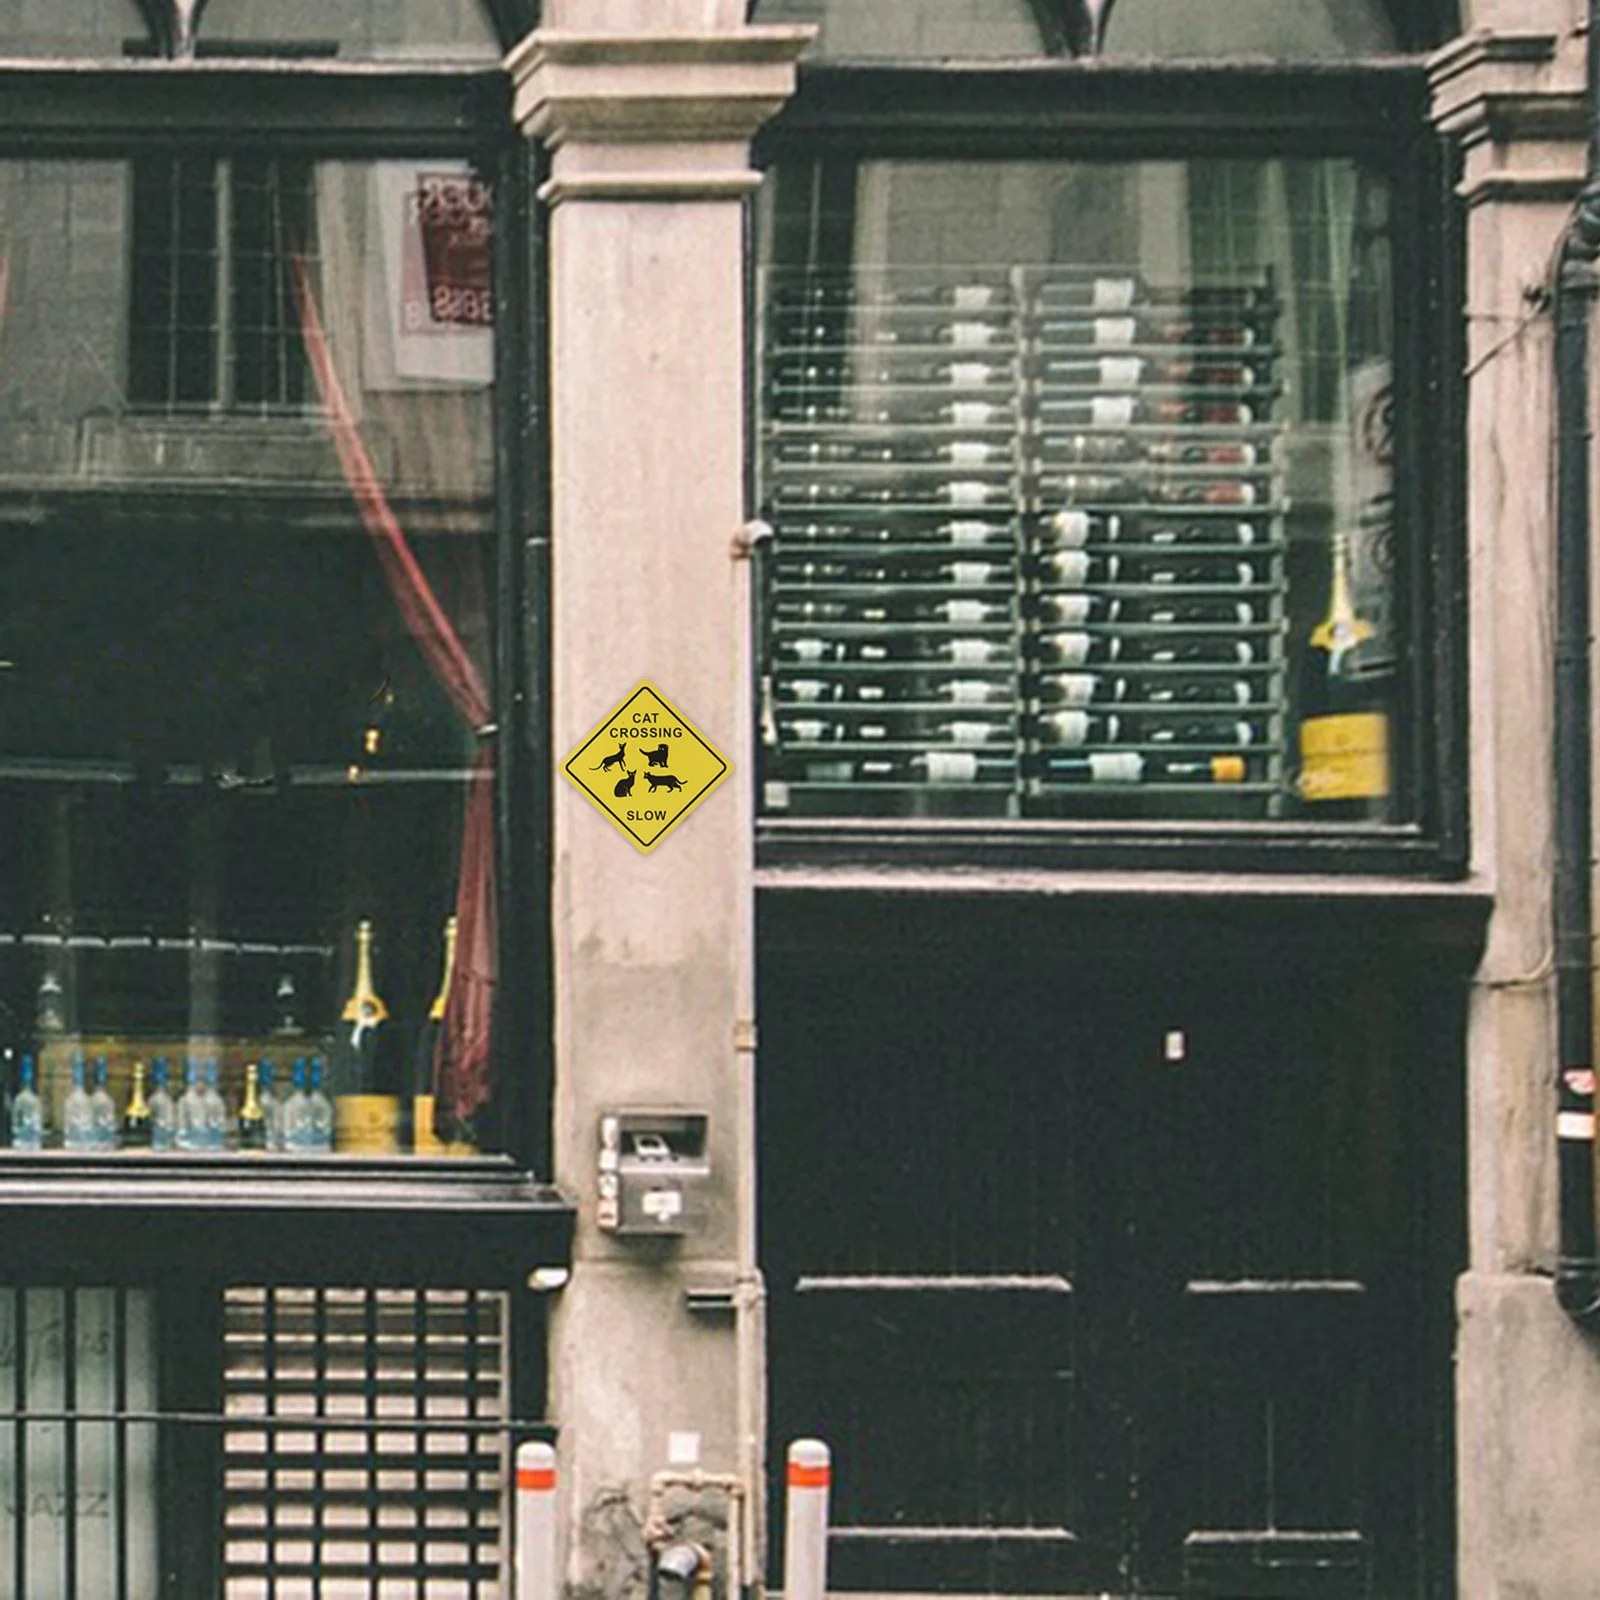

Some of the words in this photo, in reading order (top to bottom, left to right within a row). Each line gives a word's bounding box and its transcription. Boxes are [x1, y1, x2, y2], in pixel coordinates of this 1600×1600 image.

[632, 713, 659, 723] CAT
[609, 727, 683, 738] CROSSING
[626, 810, 667, 821] SLOW
